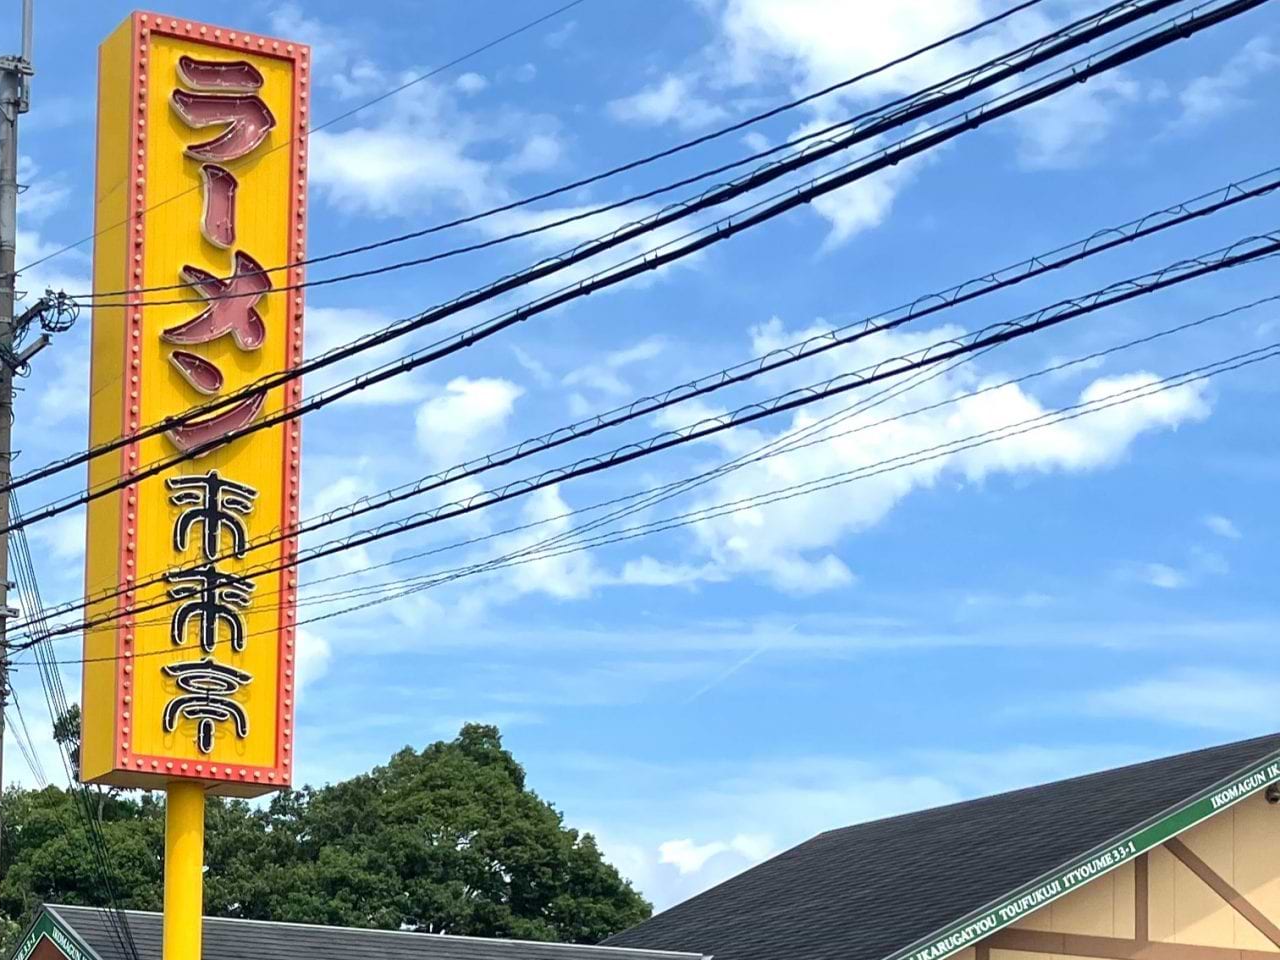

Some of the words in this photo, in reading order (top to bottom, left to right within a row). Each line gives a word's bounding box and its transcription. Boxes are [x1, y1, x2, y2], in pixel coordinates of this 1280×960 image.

[160, 55, 277, 459] ラーメン
[161, 468, 260, 755] 来来亭
[1210, 770, 1266, 809] IKOMAGUN
[999, 880, 1062, 921] TOUFUKUJI
